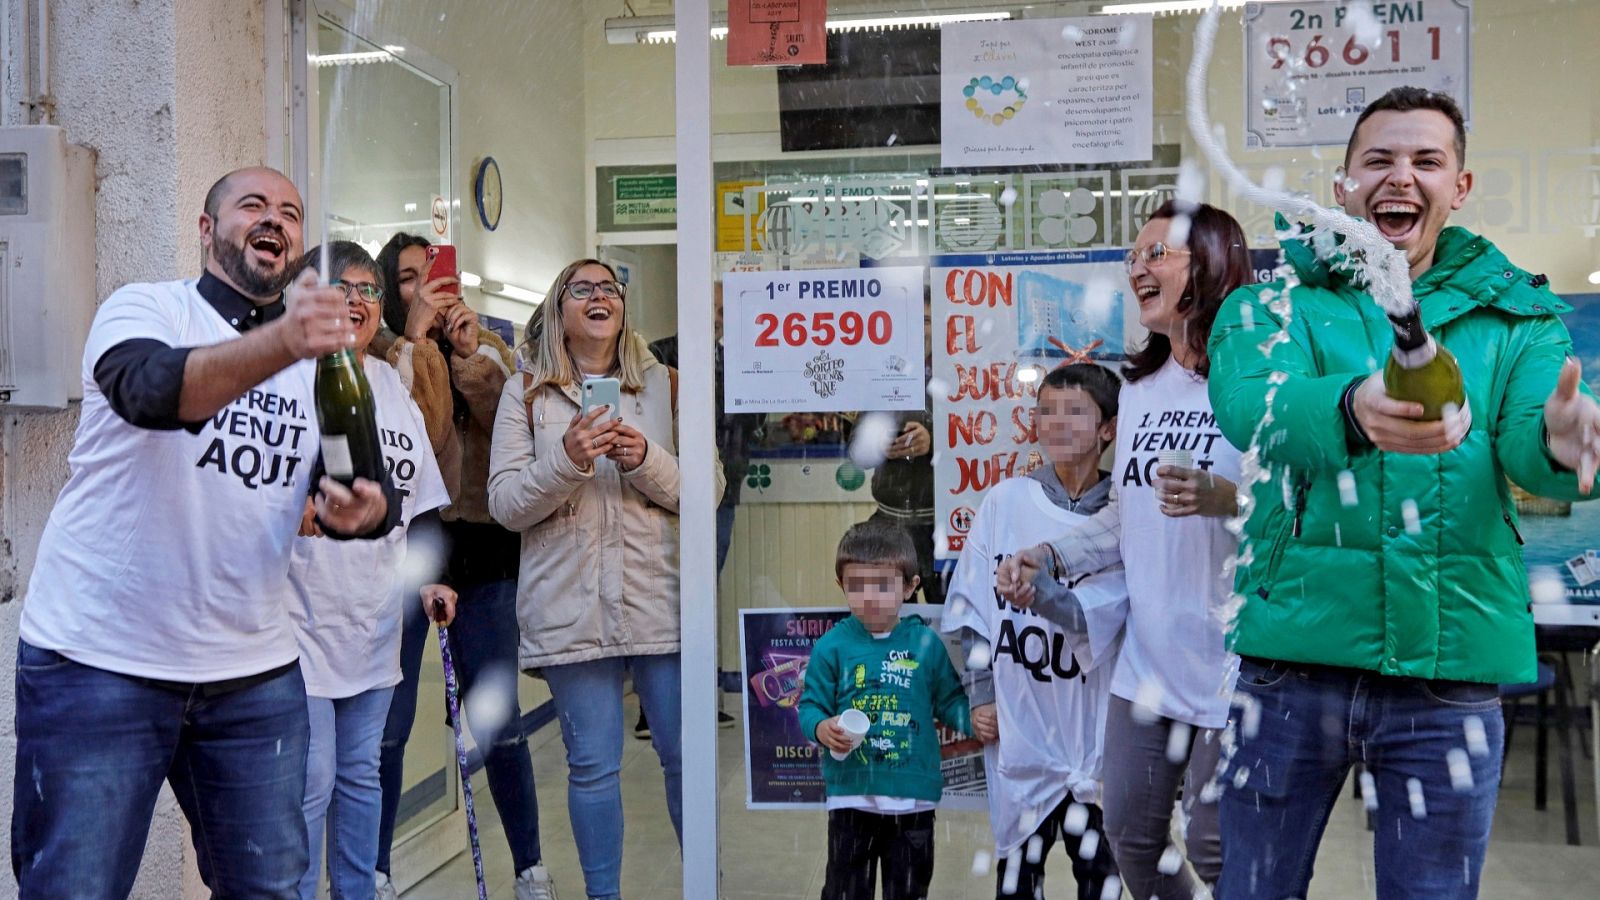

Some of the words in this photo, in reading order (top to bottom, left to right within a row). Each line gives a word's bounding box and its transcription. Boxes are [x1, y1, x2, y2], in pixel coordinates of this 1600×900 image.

[1290, 9, 1322, 30] 2n
[1335, 1, 1423, 28] PEMI
[1074, 39, 1097, 47] WEST
[1267, 26, 1440, 70] 96611
[1060, 61, 1087, 70] infantil
[1087, 62, 1098, 70] de
[1095, 74, 1110, 82] que
[1068, 84, 1114, 93] caracteritza
[1114, 83, 1128, 92] per
[1096, 94, 1121, 103] retard
[1065, 105, 1131, 115] desenvolupament
[1064, 118, 1110, 127] psicomotor
[825, 186, 874, 198] PEMIO
[1066, 252, 1086, 260] Estado
[766, 281, 790, 300] 1er
[798, 279, 882, 300] PREMIO
[945, 268, 1013, 308] CON
[754, 310, 893, 347] 26590
[946, 315, 983, 356] EL
[803, 357, 845, 378] SORTEO
[813, 373, 828, 383] QUE
[810, 380, 838, 399] UNE
[1158, 410, 1219, 429] PREM
[210, 408, 307, 450] VENUT
[947, 408, 998, 449] NO
[1131, 432, 1222, 454] VENUT
[196, 437, 302, 490] AQUÍ
[770, 638, 793, 648] FESTA
[795, 638, 810, 647] CAP
[994, 619, 1087, 684] AQU
[881, 660, 913, 677] SKATE
[879, 672, 911, 689] STYLE
[882, 729, 896, 737] NO
[775, 746, 813, 758] DISCO
